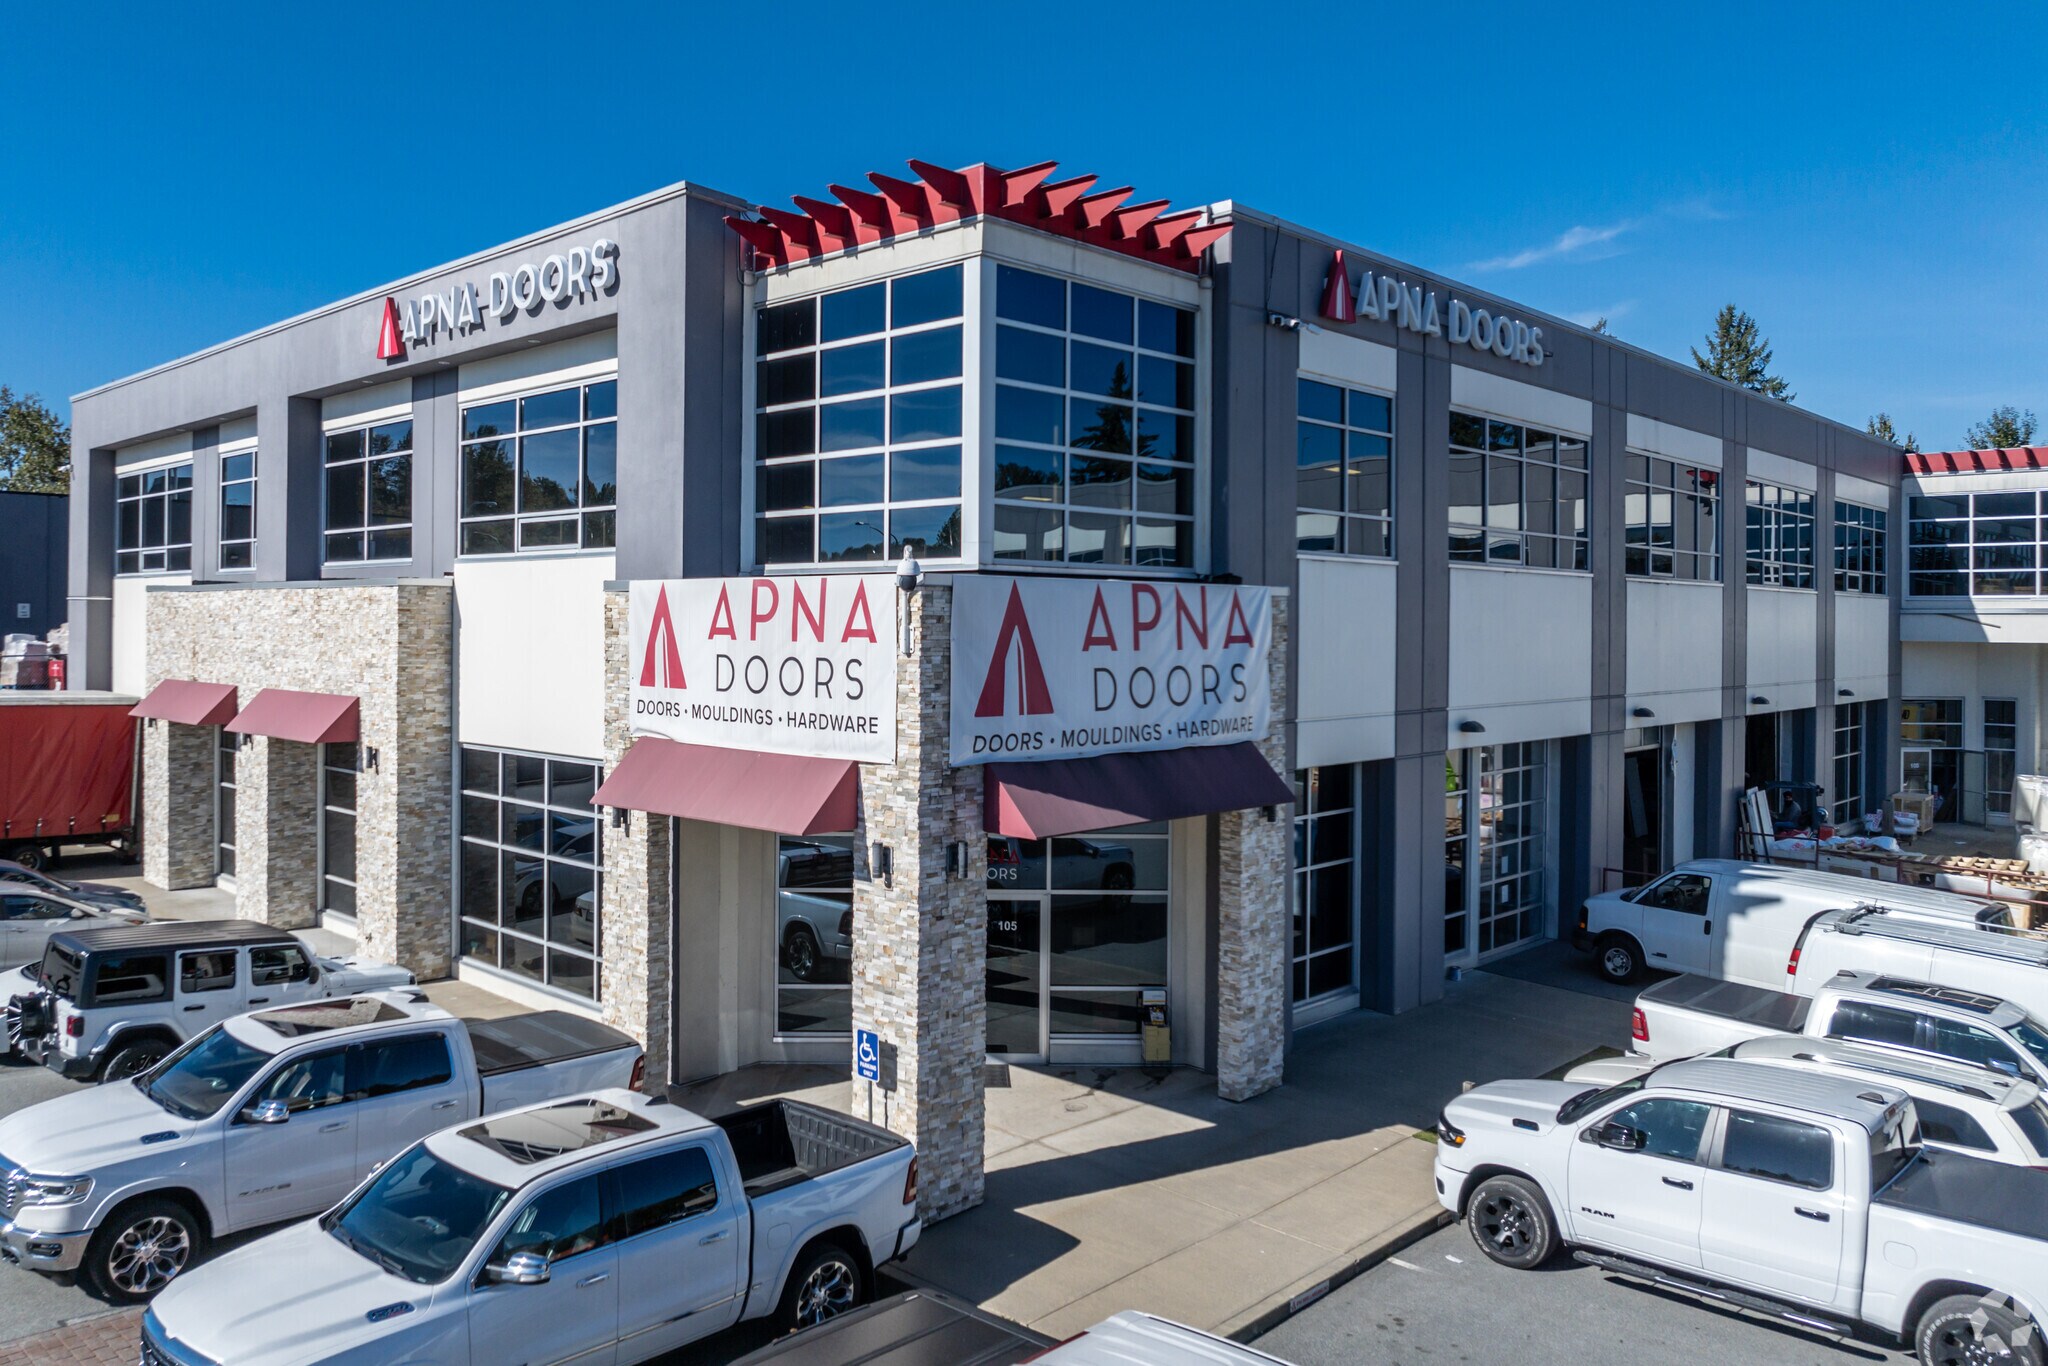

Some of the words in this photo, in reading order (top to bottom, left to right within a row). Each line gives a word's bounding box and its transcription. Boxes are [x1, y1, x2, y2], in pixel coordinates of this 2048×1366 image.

[401, 282, 480, 342] APNA
[489, 238, 617, 318] DOORS
[1356, 271, 1442, 337] APNA
[1448, 298, 1544, 367] DOORS
[707, 577, 878, 644] APNA
[1082, 583, 1255, 651] APNA
[715, 653, 865, 701] DOORS
[1093, 662, 1247, 712] DOORS
[636, 699, 681, 718] DOORS
[691, 704, 774, 726] MOULDINGS
[786, 711, 879, 734] HARDWARE
[972, 731, 1044, 754] DOORS
[1060, 722, 1163, 748] MOULDINGS
[1176, 715, 1254, 739] HARDWARE
[987, 867, 1018, 880] ORS
[990, 847, 1022, 865] NA
[998, 920, 1018, 931] 105
[859, 1060, 877, 1072] PARKING
[863, 1069, 874, 1078] ONLY
[1581, 1206, 1615, 1219] RAM
